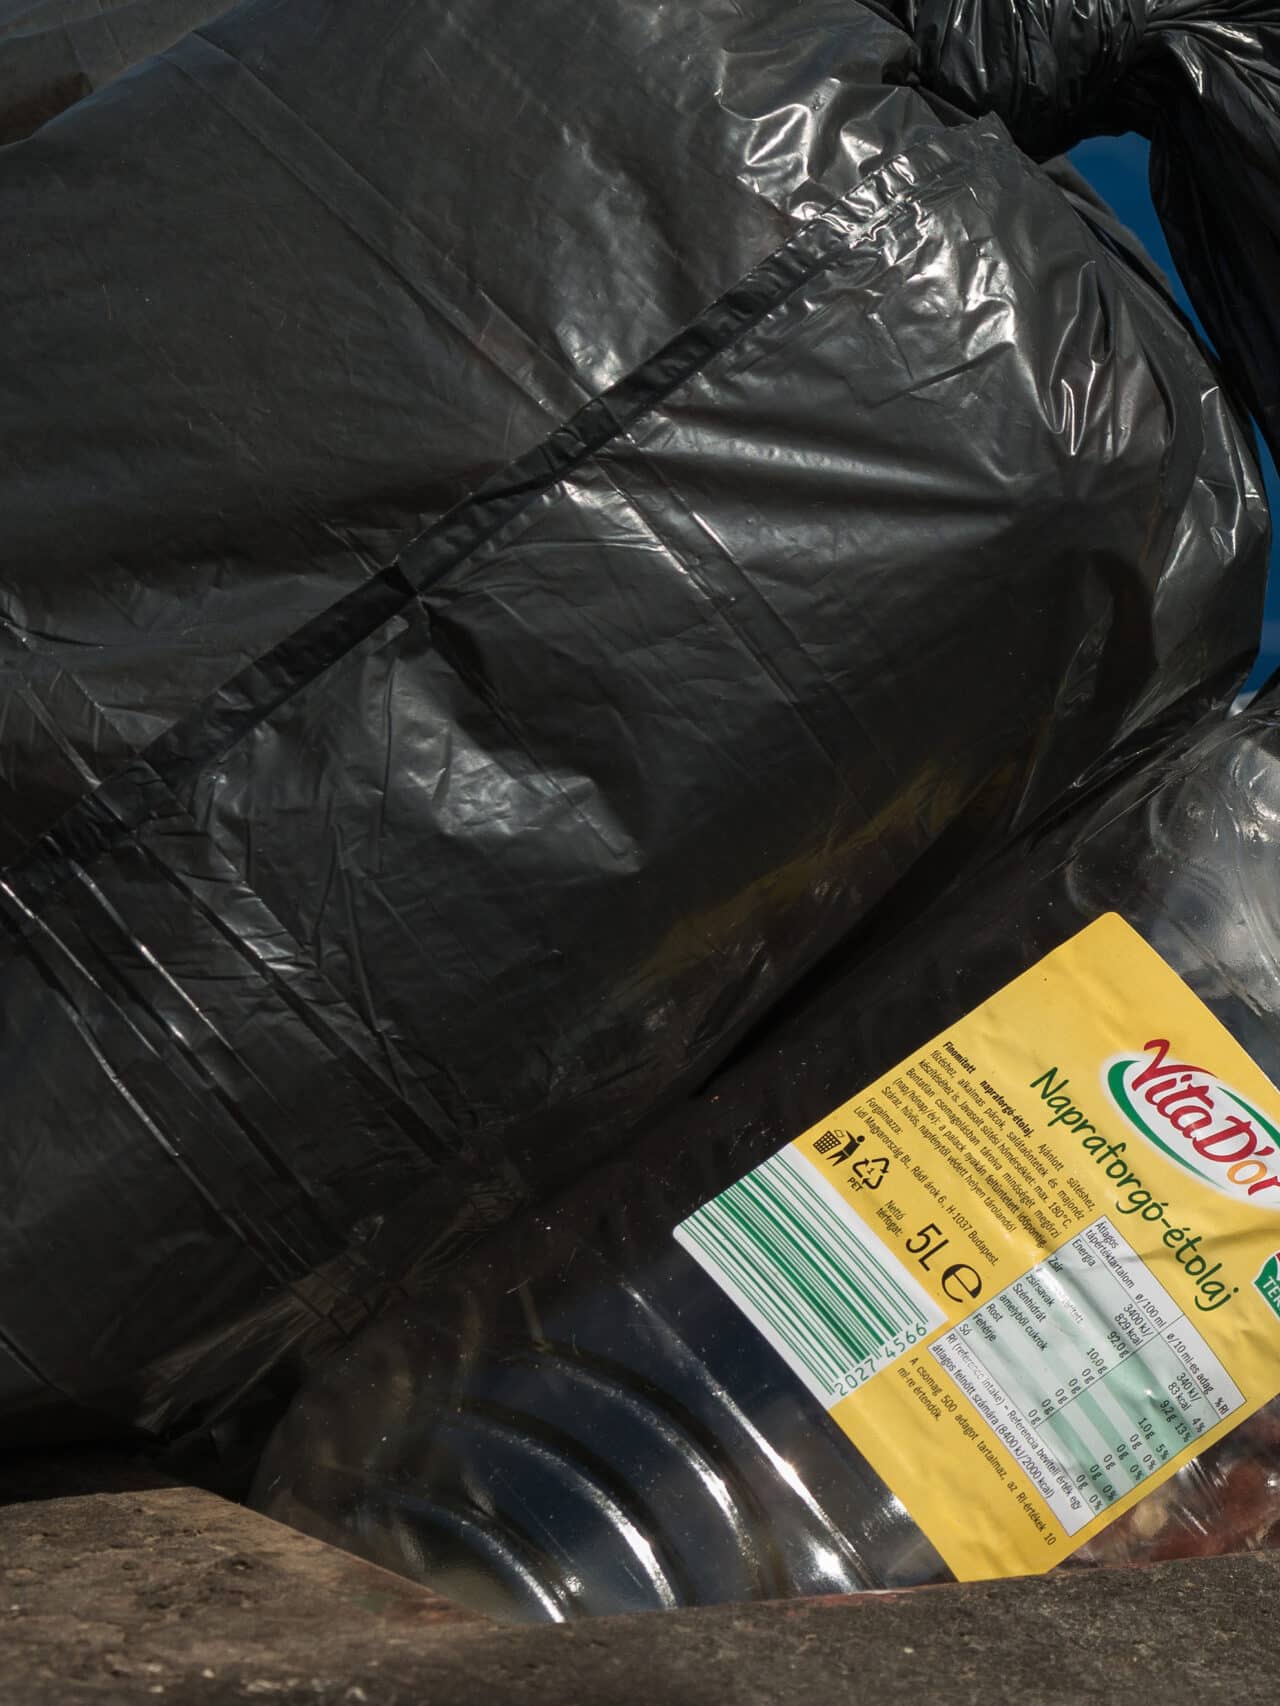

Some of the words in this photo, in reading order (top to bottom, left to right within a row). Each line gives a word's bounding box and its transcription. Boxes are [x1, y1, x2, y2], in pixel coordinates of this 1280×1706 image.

[865, 1097, 904, 1136] Forgalmazza:
[905, 1067, 936, 1098] Bontatlan
[934, 1098, 981, 1147] csomagolásban
[979, 1146, 1003, 1172] tárolva
[942, 1040, 977, 1075] Finomított
[1037, 1143, 1065, 1172] Ajánlott
[957, 1100, 985, 1128] Javasolt
[979, 1125, 1003, 1147] sütési
[853, 1105, 870, 1120] Lidl
[863, 1115, 905, 1160] Magyarország
[938, 1124, 947, 1132] a
[941, 1130, 967, 1153] palack
[957, 1078, 986, 1108] alkalmas
[1047, 1177, 1059, 1190] és
[1056, 1189, 1085, 1221] majonéz
[963, 1151, 988, 1177] nyakán
[847, 1176, 864, 1192] PET
[946, 1154, 969, 1178] védett
[963, 1173, 987, 1199] helyen
[984, 1174, 1021, 1215] feltüntetett
[1029, 1066, 1240, 1312] Napraforgó-étolaj
[884, 1199, 905, 1221] Nettó
[1071, 1238, 1097, 1268] Energia
[1094, 1220, 1119, 1249] Átlagos
[1047, 1255, 1064, 1273] Zsír
[1085, 1228, 1135, 1289] tápértéktartalom
[1012, 1282, 1047, 1323] Szénhidrát
[1025, 1273, 1056, 1308] zsírsavak
[958, 1323, 973, 1337] Só
[971, 1312, 997, 1343] Fehérje
[985, 1302, 1004, 1323] Rost
[998, 1294, 1030, 1327] amelyből
[1024, 1325, 1048, 1352] cukrok
[833, 1357, 877, 1397] 2027
[884, 1322, 928, 1359] 4566
[931, 1344, 957, 1372] átlagos
[953, 1368, 977, 1397] felnőtt
[971, 1393, 1000, 1426] számára
[981, 1377, 1006, 1406] intake)
[1192, 1373, 1215, 1396] adag
[909, 1357, 919, 1366] A
[916, 1366, 943, 1397] csomag
[940, 1393, 958, 1413] 500
[954, 1413, 980, 1441] adagot
[1006, 1480, 1018, 1493] az
[1043, 1532, 1057, 1546] 10
